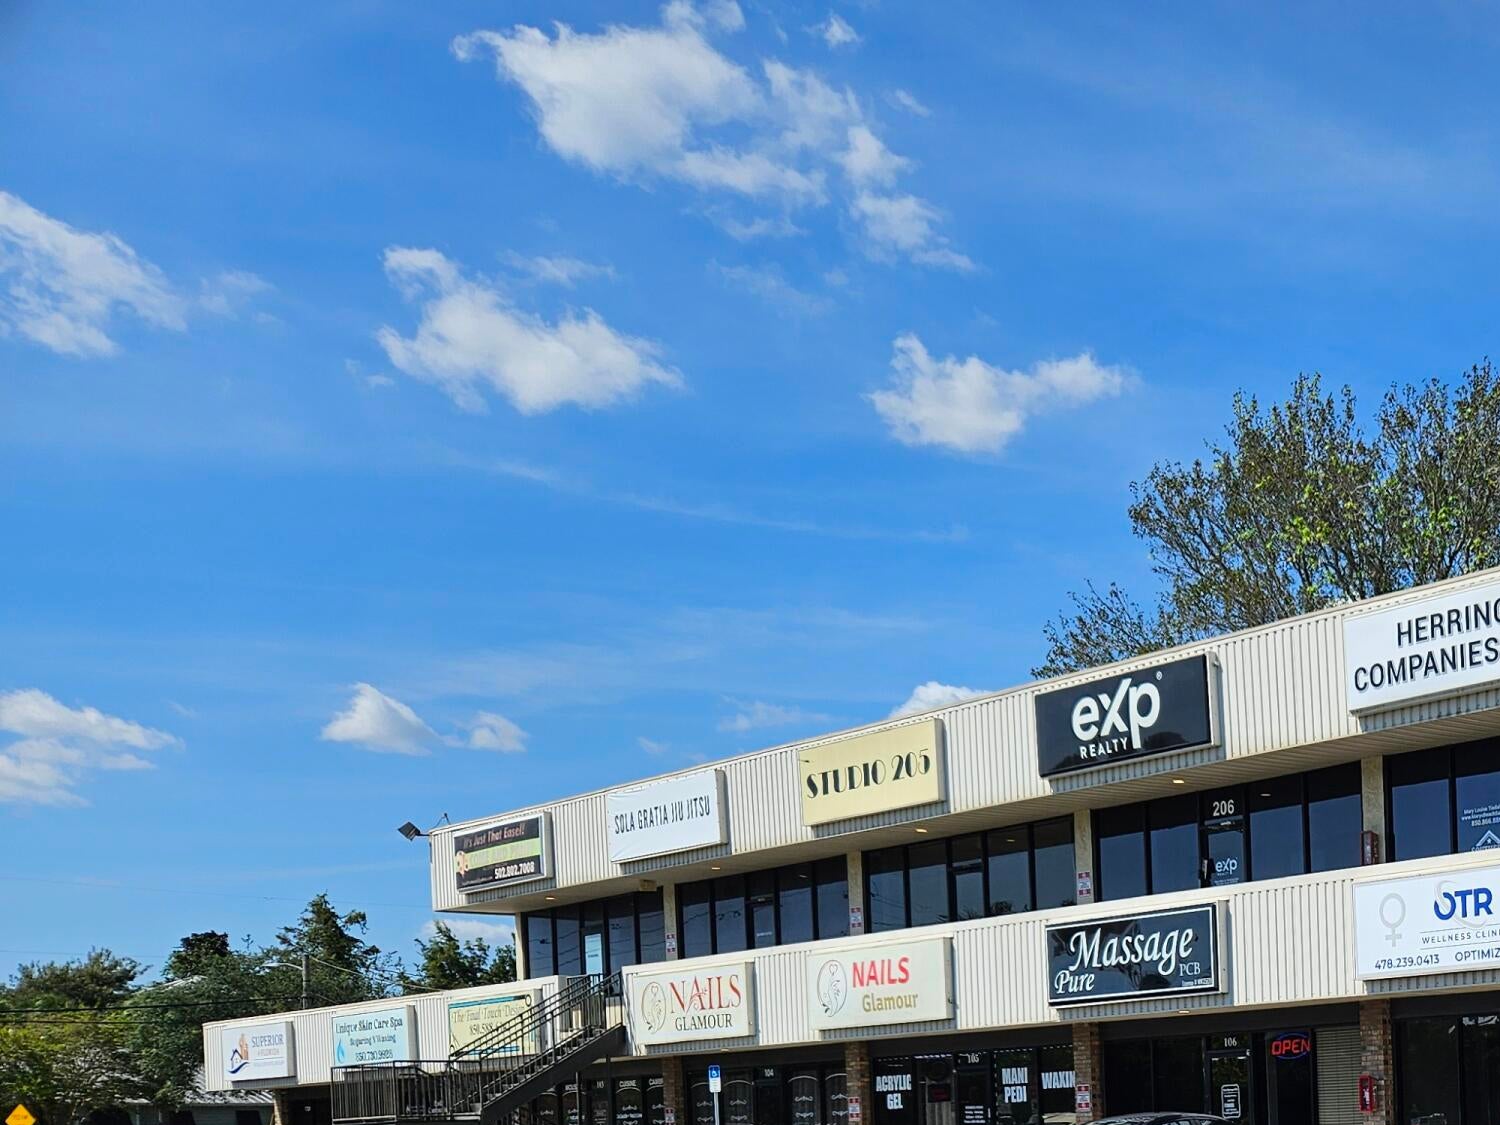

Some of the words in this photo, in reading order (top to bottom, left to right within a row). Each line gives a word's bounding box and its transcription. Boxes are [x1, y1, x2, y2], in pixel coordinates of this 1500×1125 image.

[1354, 637, 1500, 692] COMPANIES
[1079, 736, 1128, 760] REALTY
[806, 759, 887, 799] STUDIO
[890, 748, 931, 781] 205
[614, 811, 636, 835] SOLA
[637, 804, 669, 830] GRATIA
[670, 801, 684, 823] JIU
[686, 795, 711, 820] JITSU
[1212, 799, 1235, 817] 206
[1433, 887, 1493, 921] OTR
[1421, 931, 1472, 944] WELLNESS
[1069, 927, 1194, 976] Massage
[1179, 962, 1201, 977] PCB
[1374, 953, 1440, 970] 478.239.0413
[852, 957, 910, 988] NAILS
[1054, 969, 1095, 994] Pure
[669, 974, 742, 1015] NAILS
[862, 992, 919, 1013] Glamour
[335, 1023, 358, 1036] Unique
[358, 1019, 373, 1031] Skin
[373, 1018, 390, 1030] Care
[390, 1016, 404, 1030] Spa
[675, 1013, 734, 1032] GLAMOUR
[251, 1034, 285, 1048] SUPERIOR
[1223, 1037, 1238, 1047] 106
[1271, 1038, 1311, 1056] OPEN
[764, 1068, 774, 1077] 104
[1001, 1067, 1029, 1085] MANI
[875, 1073, 913, 1092] ACRYLIC
[886, 1093, 904, 1110] GEL
[1003, 1085, 1028, 1104] PEDI
